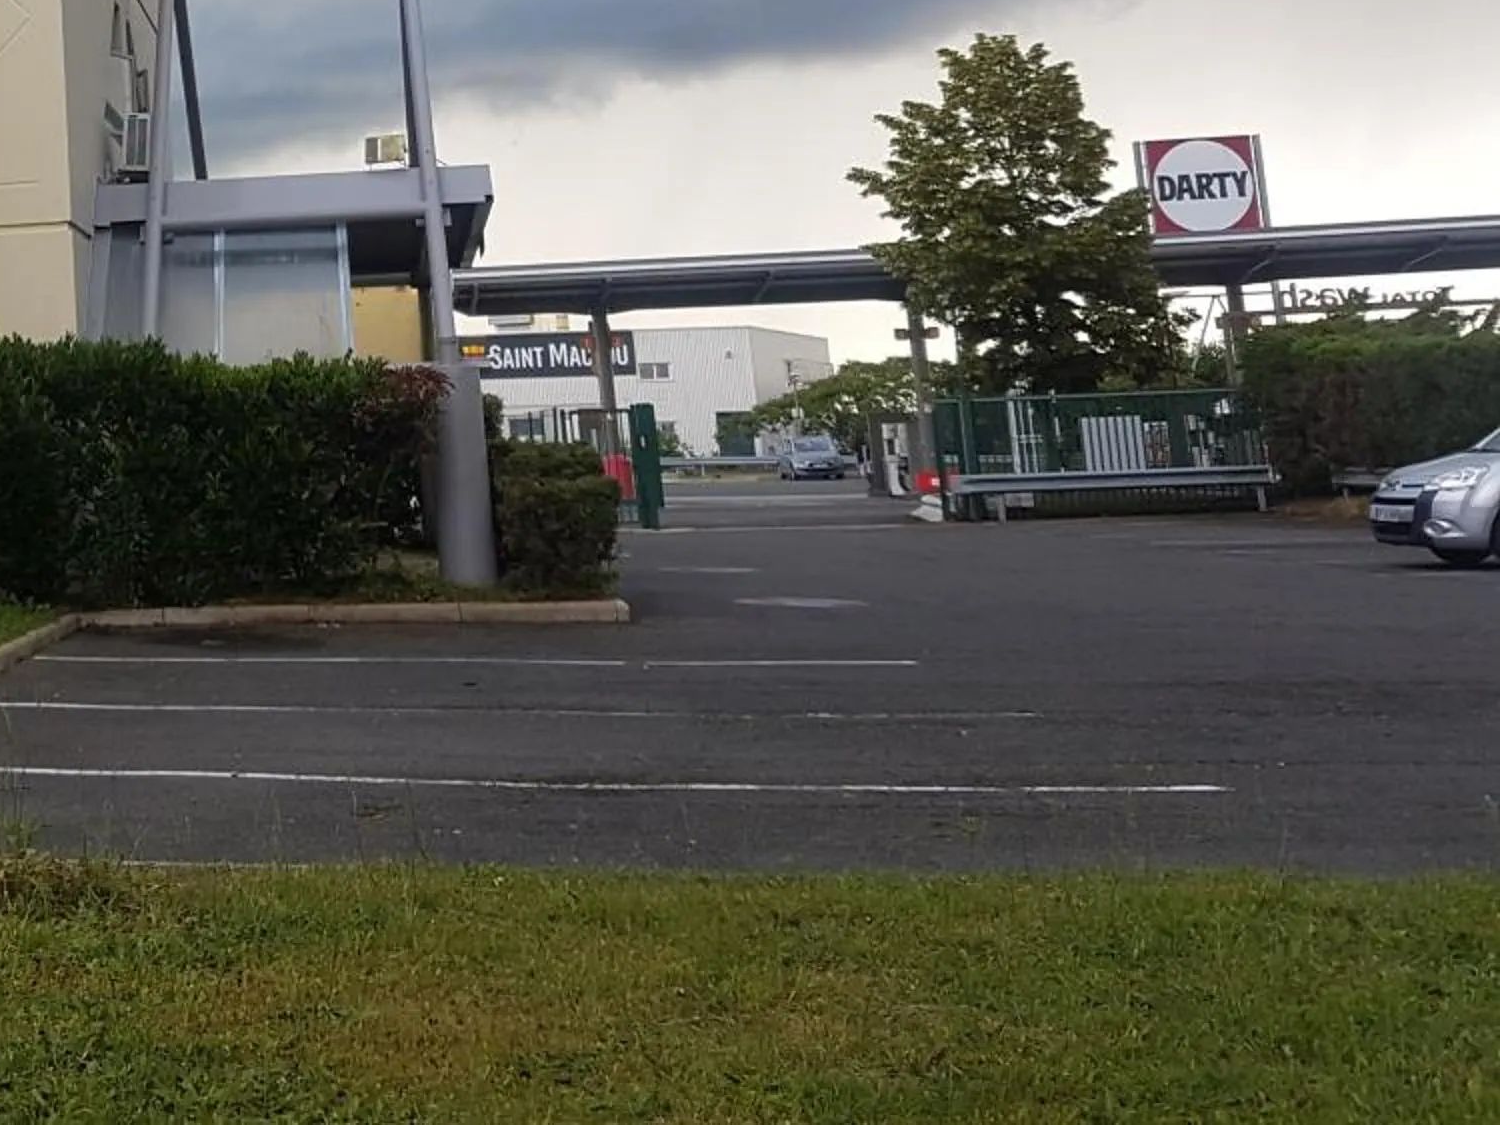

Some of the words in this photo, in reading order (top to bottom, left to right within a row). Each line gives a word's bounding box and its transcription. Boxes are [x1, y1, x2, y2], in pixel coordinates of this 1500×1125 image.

[1157, 170, 1249, 203] DARTY
[488, 344, 545, 370] SAINT
[549, 342, 629, 368] MACU
